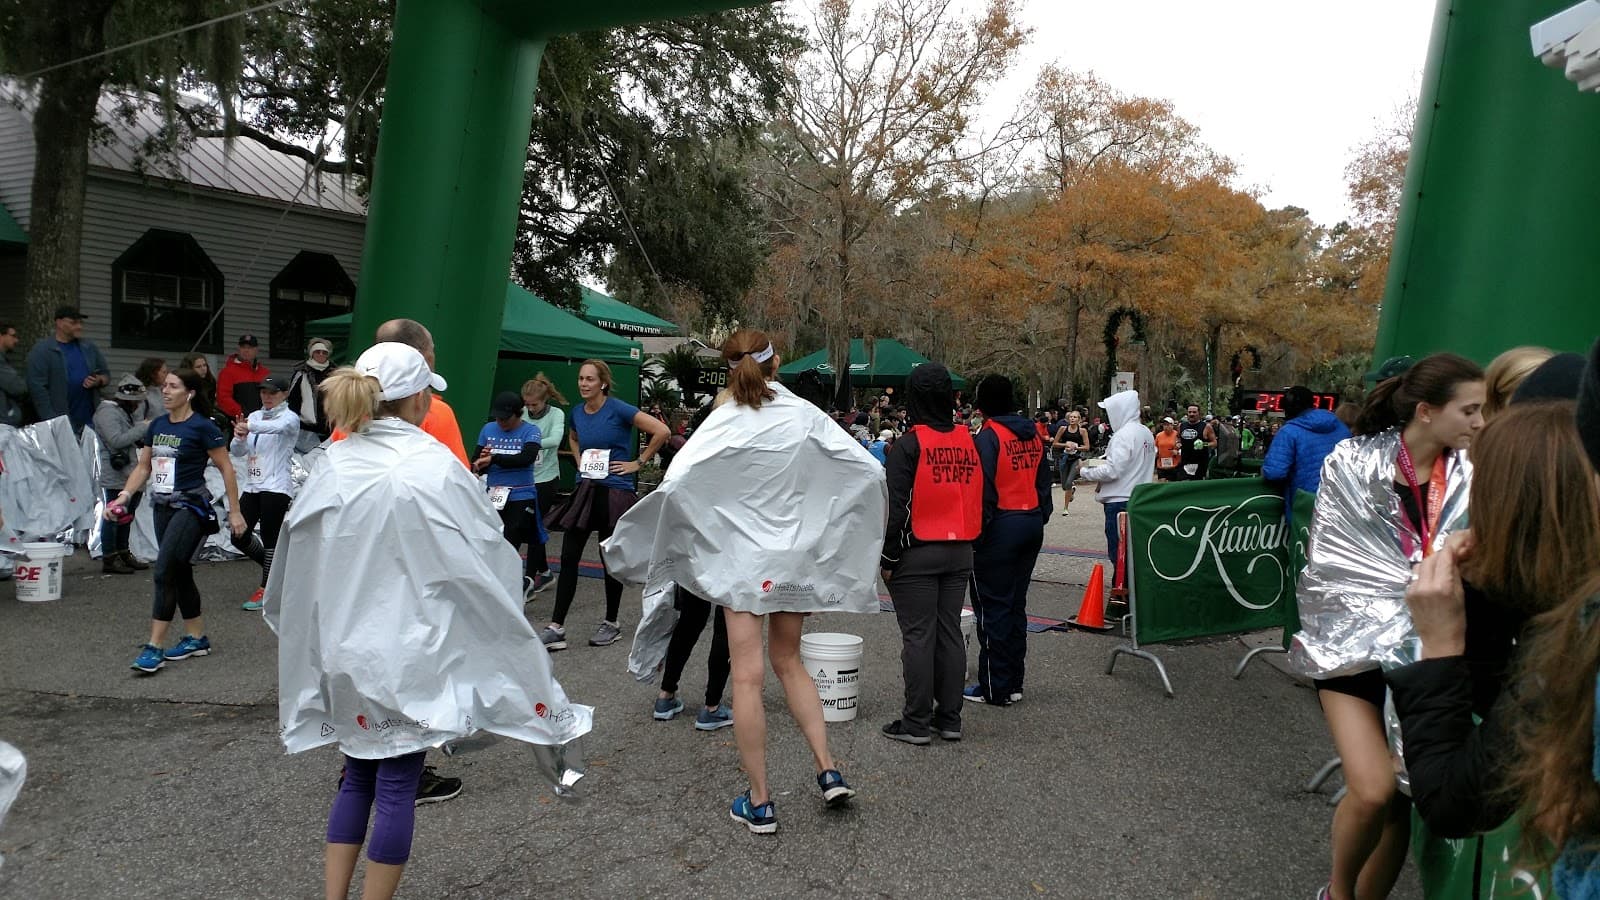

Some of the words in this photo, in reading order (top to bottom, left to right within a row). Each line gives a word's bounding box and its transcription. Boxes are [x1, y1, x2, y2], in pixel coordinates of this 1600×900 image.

[597, 320, 616, 329] VILLA
[620, 323, 661, 334] REGISTRATION
[698, 371, 726, 385] 2:08
[1003, 435, 1042, 456] MEDICAL
[926, 447, 978, 467] MEDICAL
[1011, 454, 1041, 472] STAFF
[584, 462, 605, 472] 1589
[932, 465, 975, 485] STAFF
[1148, 494, 1289, 610] Kiawah
[16, 566, 42, 581] CE
